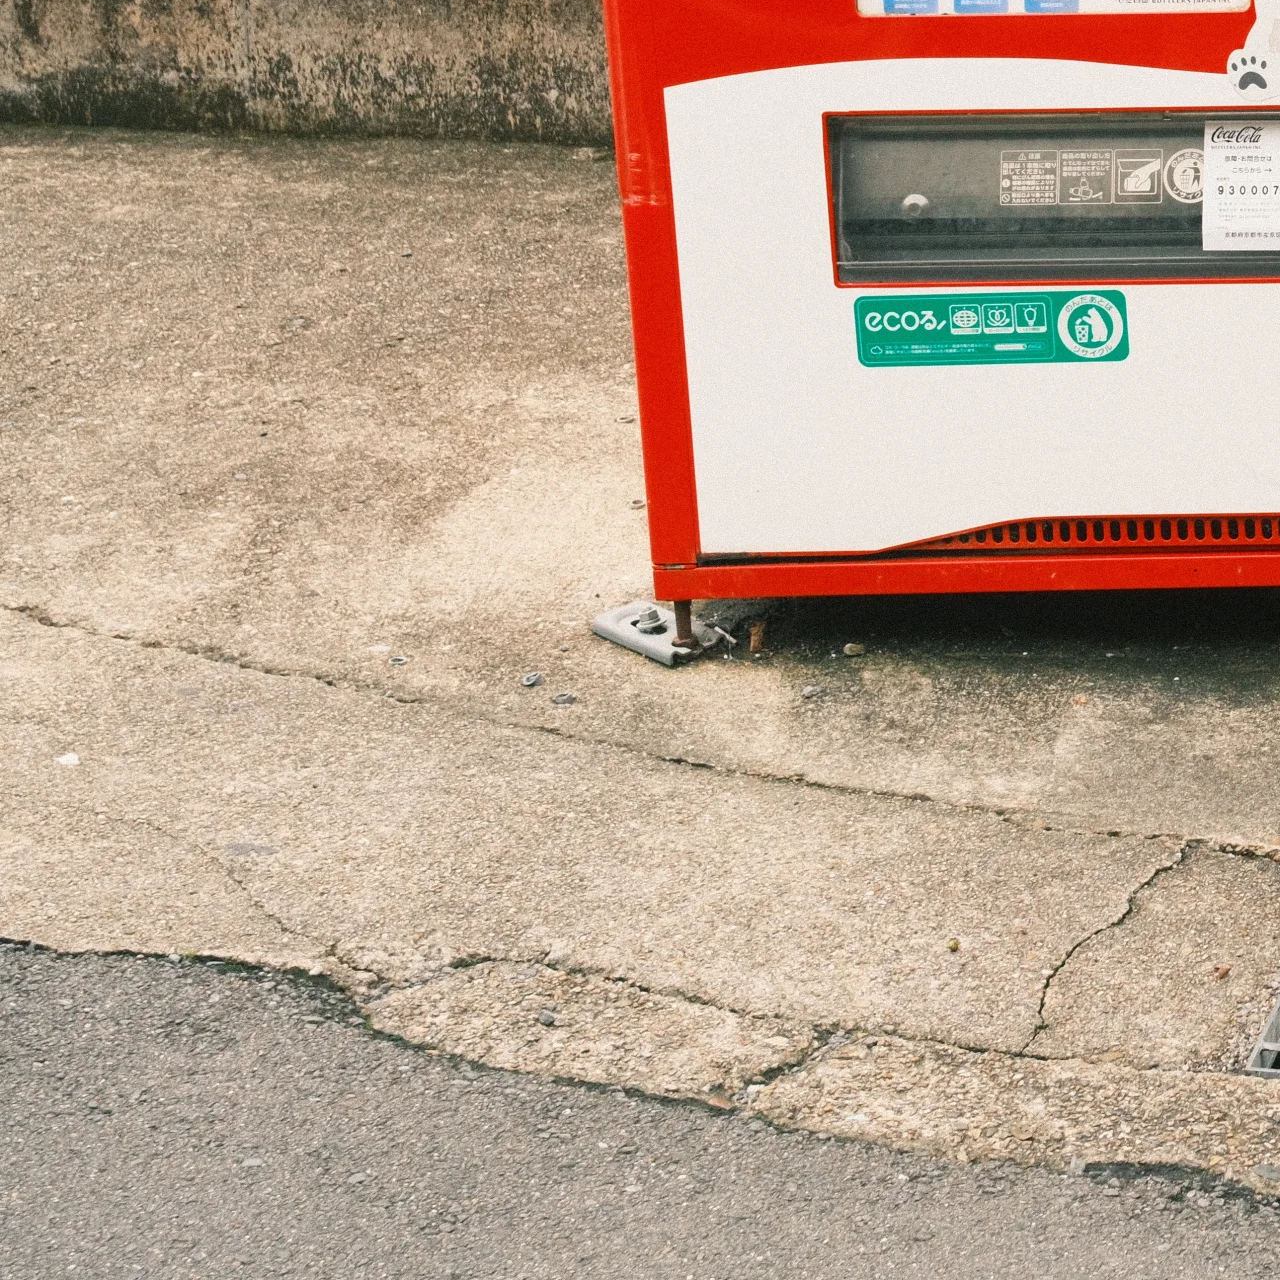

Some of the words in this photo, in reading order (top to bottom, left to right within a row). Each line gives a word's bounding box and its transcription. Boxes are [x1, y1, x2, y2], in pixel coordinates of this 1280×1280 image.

[1211, 126, 1265, 144] Coca-Cola
[1064, 295, 1113, 313] のんだあとは
[1073, 343, 1113, 358] リサイクル
